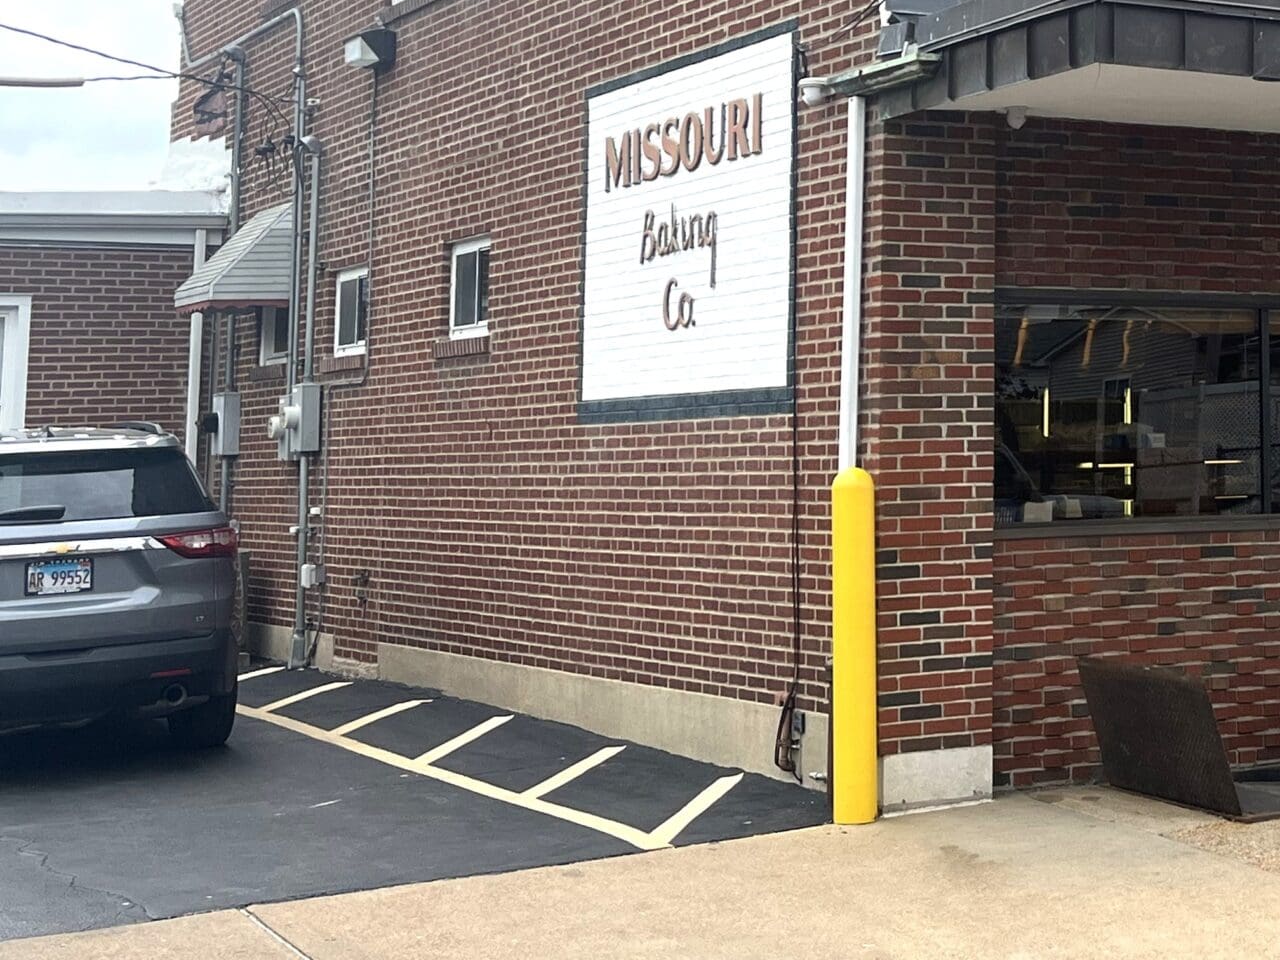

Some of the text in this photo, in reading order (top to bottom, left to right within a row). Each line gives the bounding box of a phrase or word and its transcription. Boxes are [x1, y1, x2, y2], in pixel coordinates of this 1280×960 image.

[604, 92, 763, 193] MISSOURI
[639, 203, 718, 289] Baking
[662, 277, 696, 331] Co.
[51, 568, 90, 586] 99552
